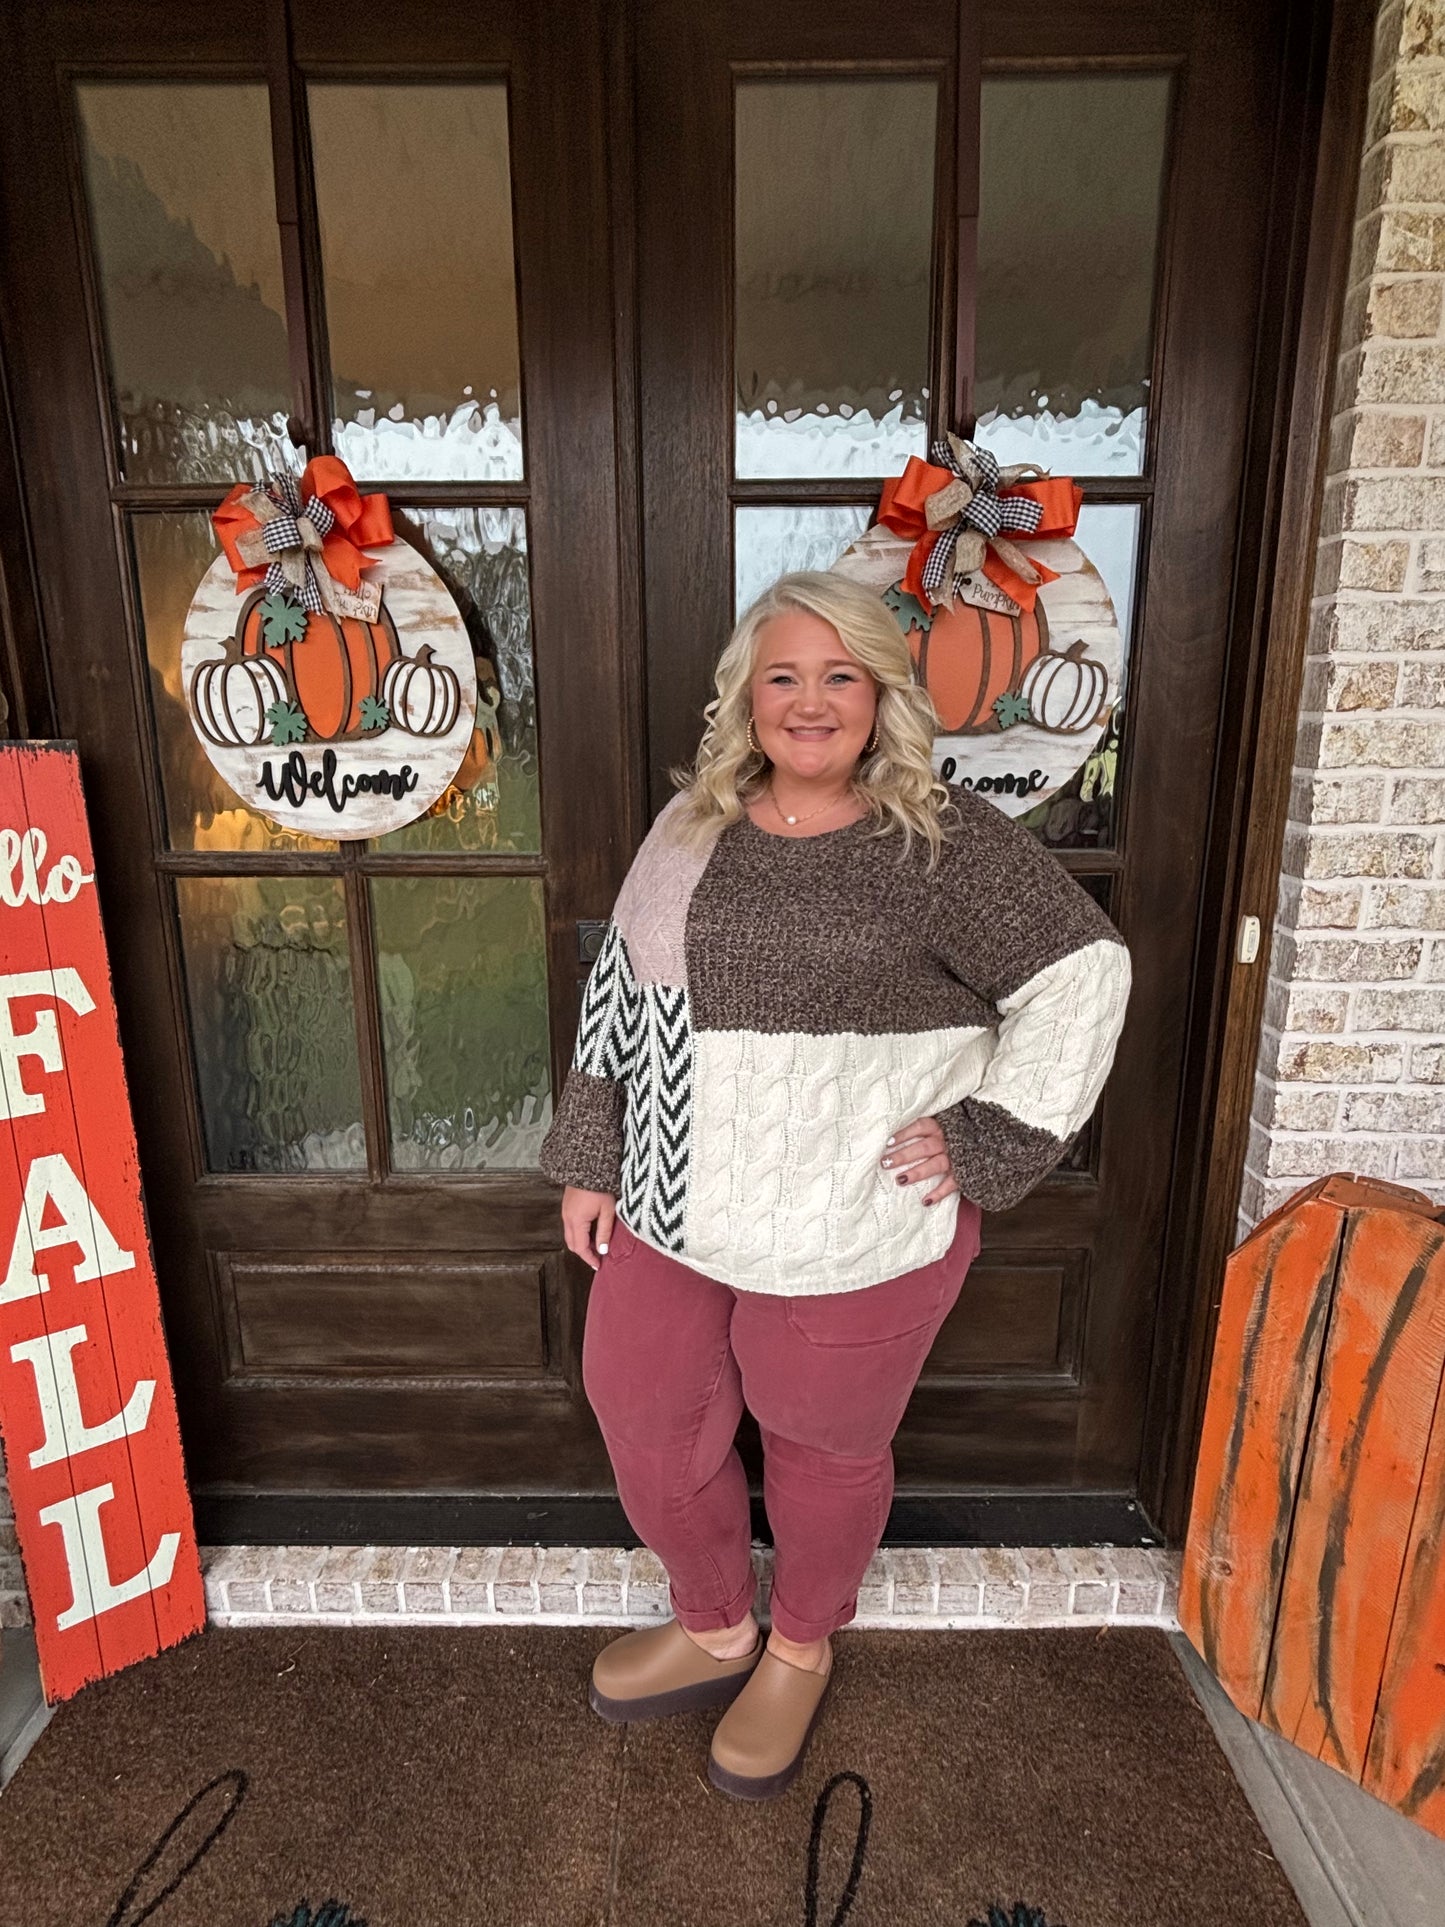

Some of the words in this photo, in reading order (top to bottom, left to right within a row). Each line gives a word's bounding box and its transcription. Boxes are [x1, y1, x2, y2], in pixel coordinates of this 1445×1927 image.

[255, 748, 419, 813] Welcome
[0, 827, 95, 907] llo
[0, 967, 182, 1632] FALL
